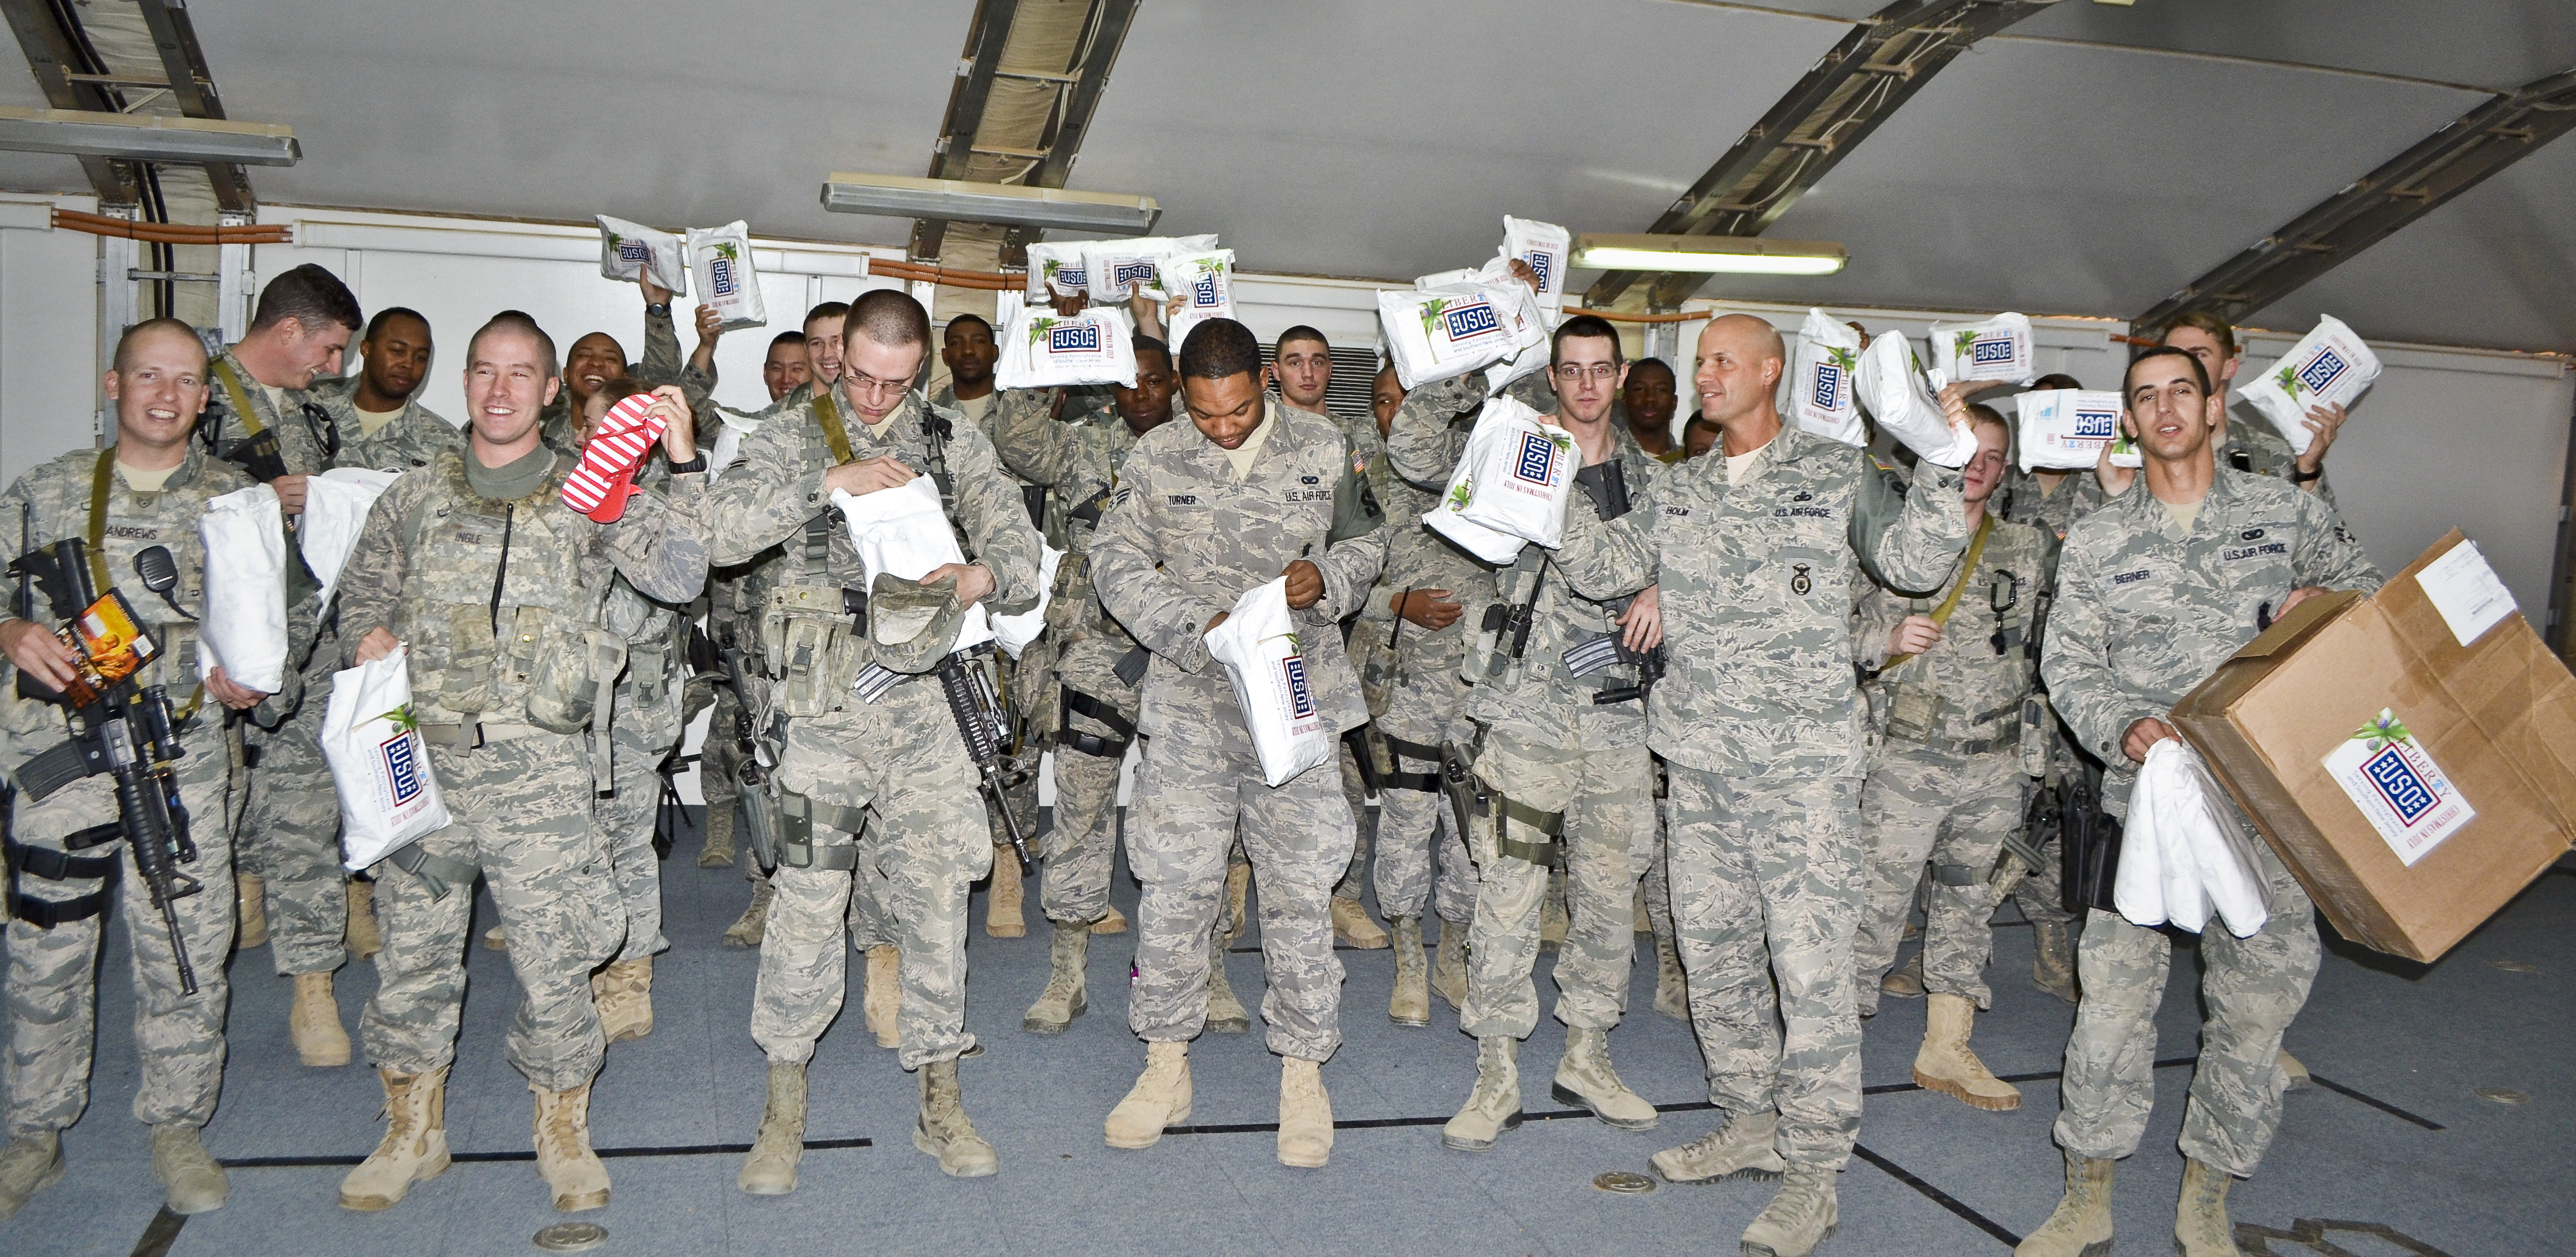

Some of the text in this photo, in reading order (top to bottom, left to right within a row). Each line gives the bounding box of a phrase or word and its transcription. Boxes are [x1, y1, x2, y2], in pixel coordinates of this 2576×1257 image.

[625, 247, 645, 259] USO
[715, 265, 729, 288] USO
[1064, 272, 1082, 283] USO
[1124, 267, 1145, 280] USO
[1196, 277, 1213, 298] USO
[1441, 294, 1485, 309] LIBERT
[1456, 309, 1489, 331] USO
[1060, 330, 1089, 346] USO
[1981, 344, 2005, 359] USO
[2308, 358, 2337, 384] USO
[1818, 373, 1836, 400] USO
[2076, 416, 2105, 434] USO
[1524, 443, 1548, 472] USO
[1168, 495, 1196, 506] TURNER
[1302, 491, 1315, 501] AIR
[1666, 506, 1689, 516] HOLM
[106, 525, 157, 539] ANDREWS
[455, 531, 481, 544] INGLE
[2114, 570, 2150, 585] BERNER
[1274, 670, 1282, 693] Southern
[1292, 669, 1307, 704] USO
[1282, 682, 1293, 720] Pennsylvania
[373, 746, 383, 770] Serving
[392, 747, 414, 789] USO
[2397, 737, 2451, 797] LIBERTY
[2379, 762, 2422, 807] USO
[2347, 776, 2357, 786] and
[2356, 785, 2375, 809] Southern
[2375, 808, 2385, 821] New
[2384, 821, 2398, 837] Jersey
[2353, 771, 2372, 794] Serving
[2371, 794, 2403, 833] Pennsylvania
[2426, 805, 2460, 834] CHRISTMAS
[2406, 833, 2423, 850] JULY
[2419, 829, 2430, 840] IN
